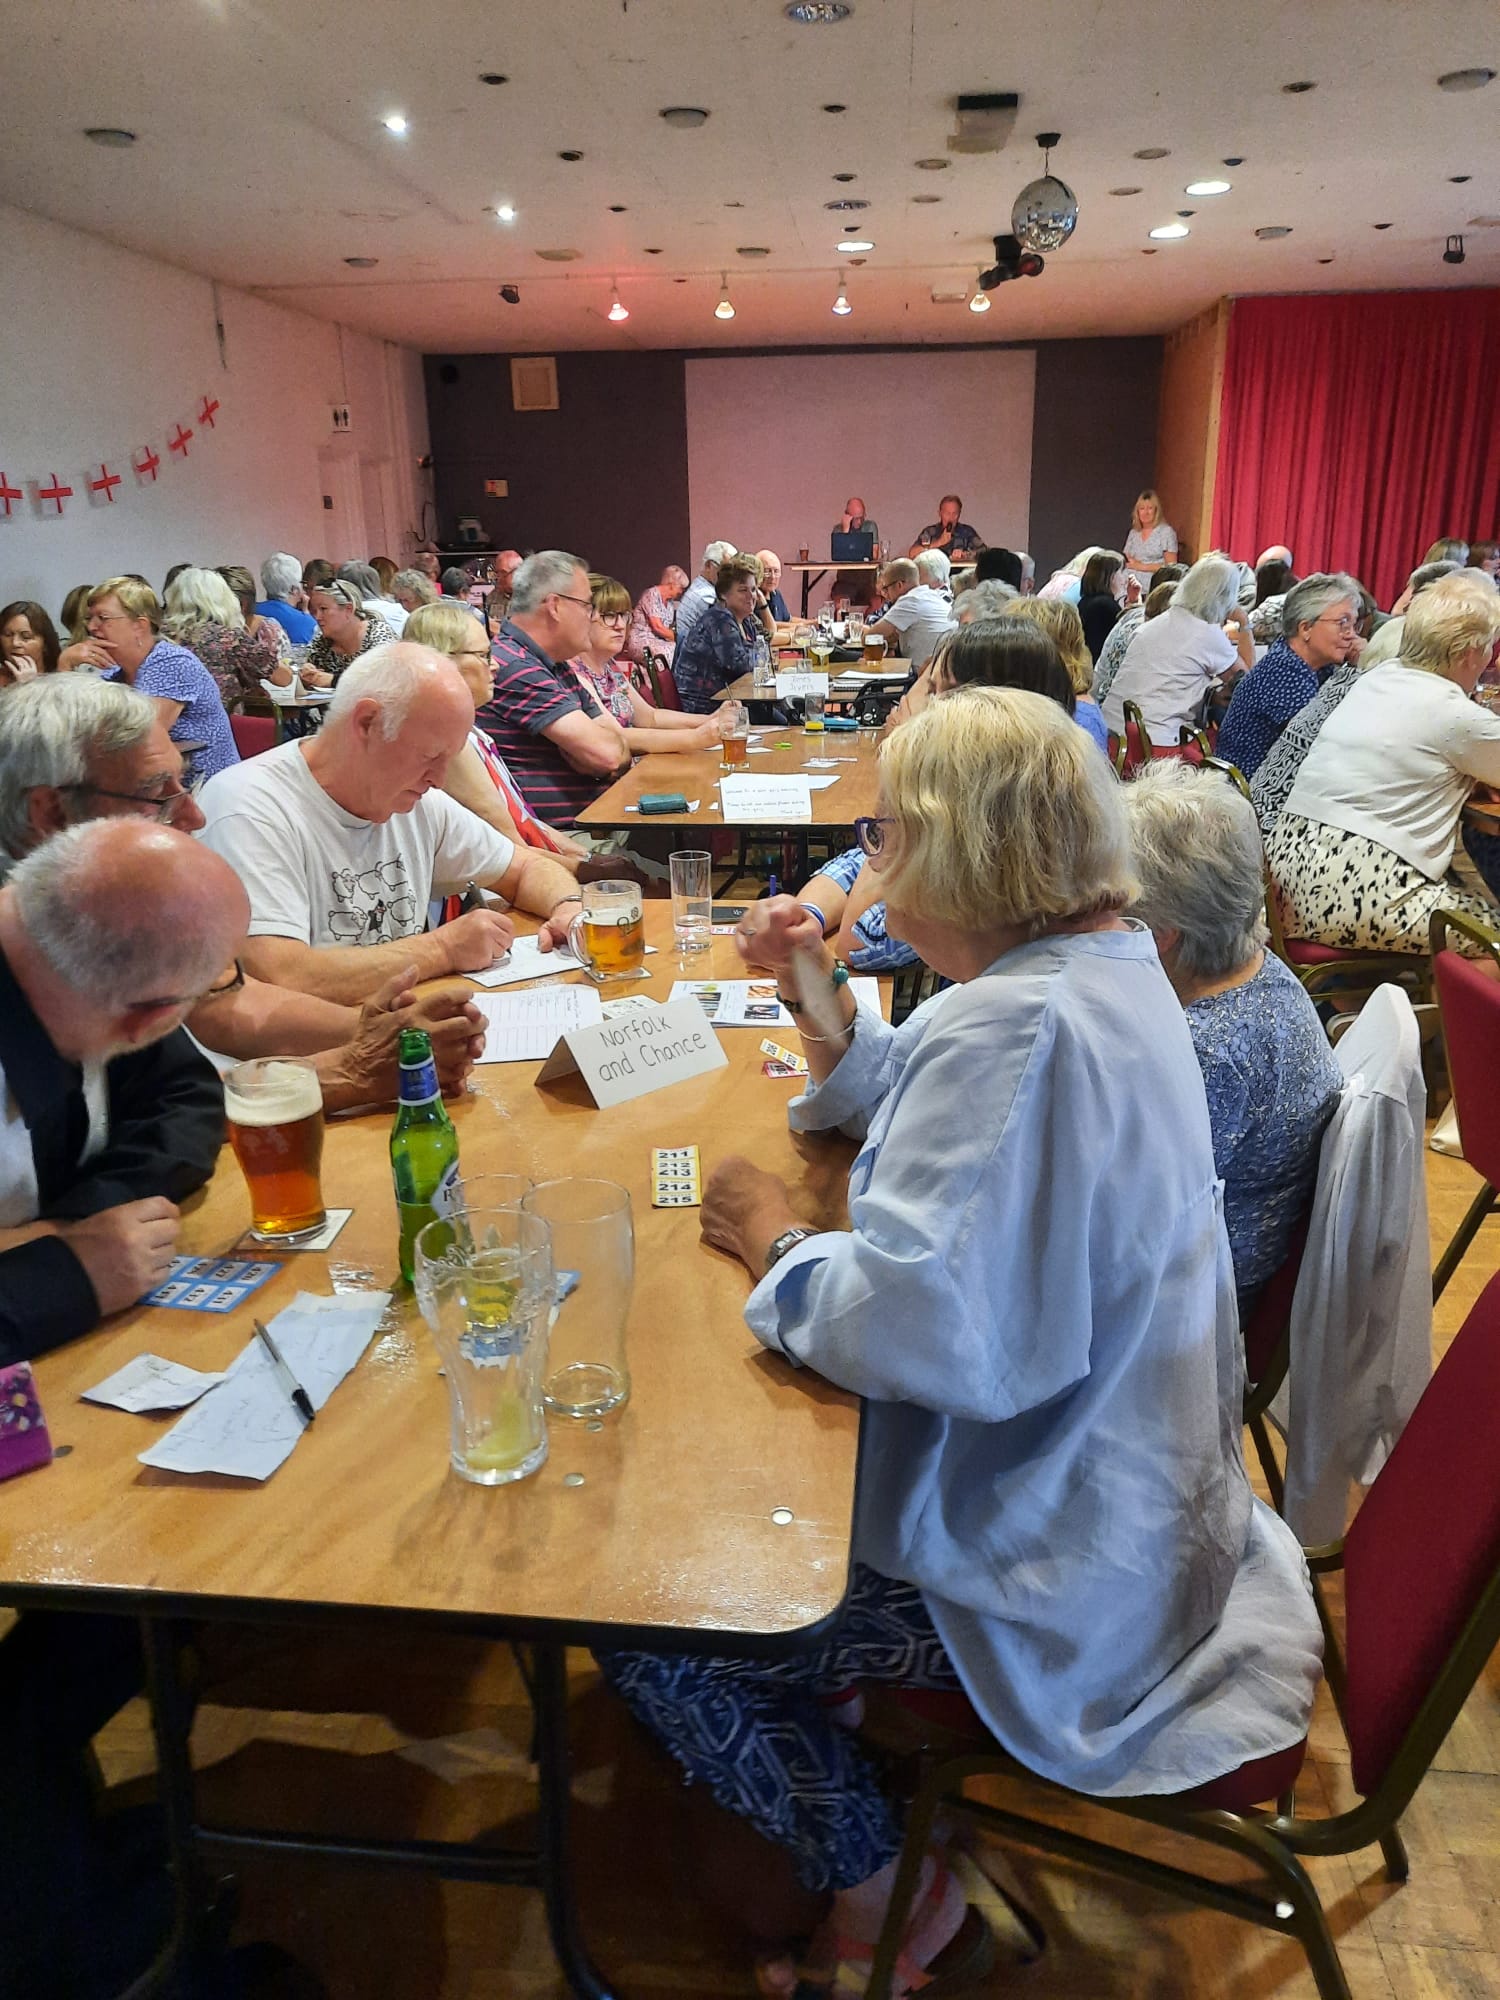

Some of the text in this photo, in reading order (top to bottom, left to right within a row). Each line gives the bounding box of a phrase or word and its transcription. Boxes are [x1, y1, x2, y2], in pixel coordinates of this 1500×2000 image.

[599, 1015, 672, 1048] Norfolk
[599, 1032, 707, 1081] and Chance
[658, 1150, 689, 1159] 211
[658, 1168, 691, 1177] 213
[658, 1183, 692, 1191] 214
[658, 1196, 692, 1204] 215
